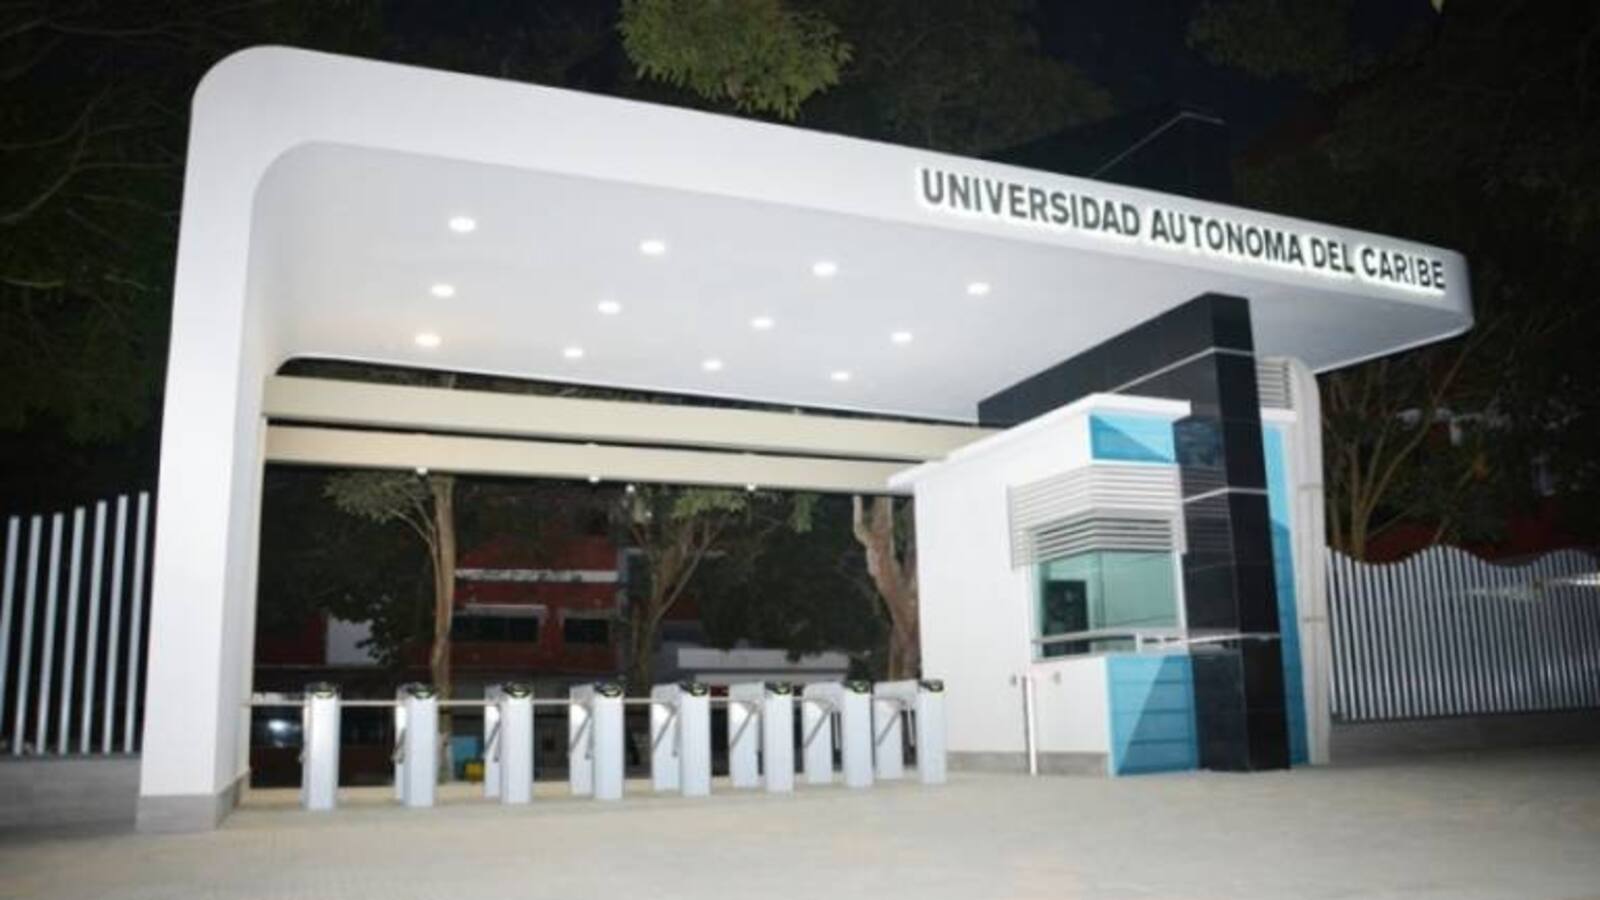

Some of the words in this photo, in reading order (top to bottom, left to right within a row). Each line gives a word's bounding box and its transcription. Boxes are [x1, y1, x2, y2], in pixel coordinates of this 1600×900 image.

[922, 168, 1141, 236] UNIVERSIDAD
[1150, 209, 1304, 266] AUTONOMA
[1310, 237, 1355, 274] DEL
[1361, 248, 1446, 289] CARIBE
